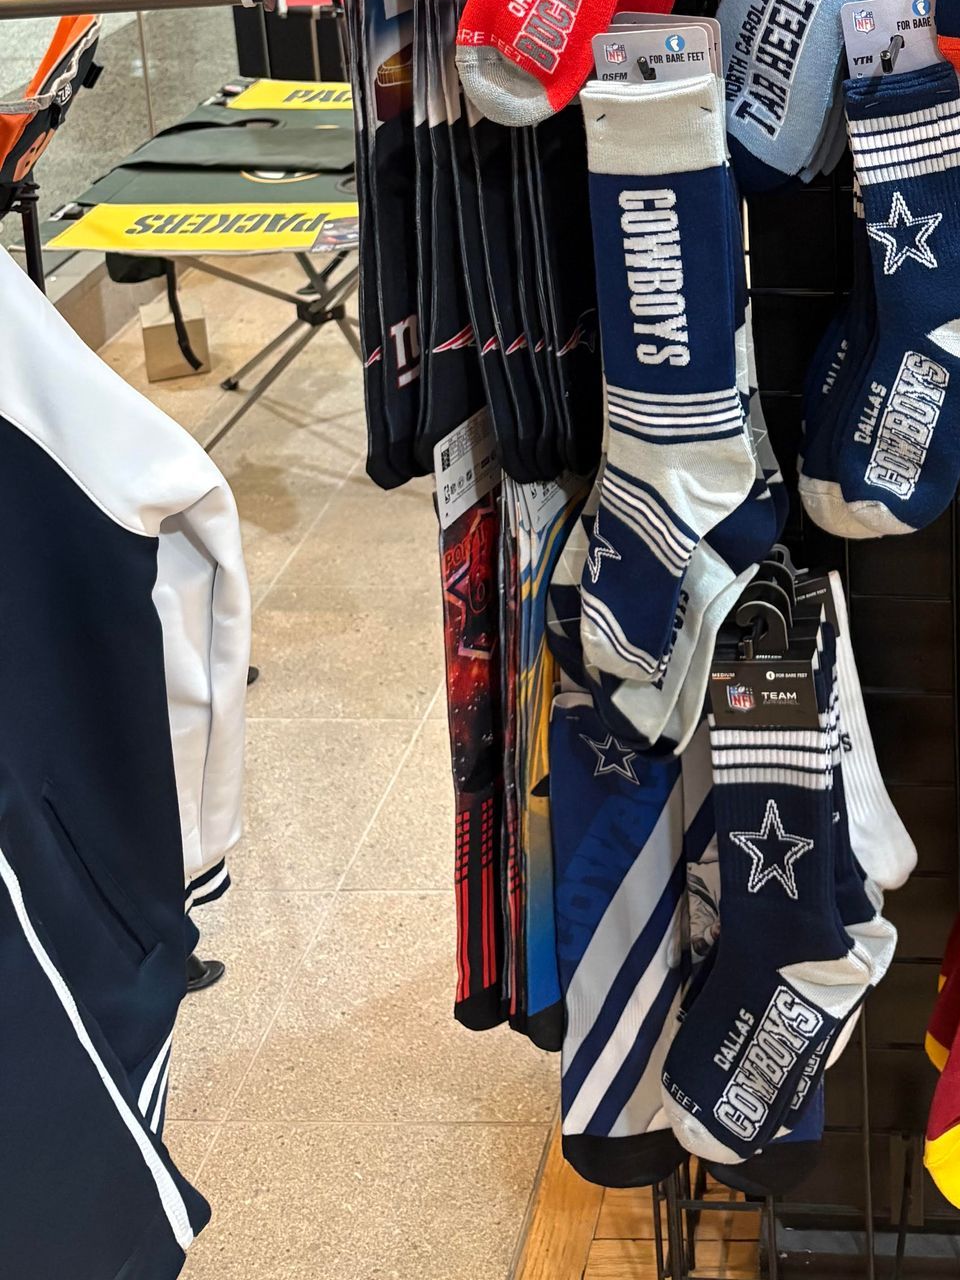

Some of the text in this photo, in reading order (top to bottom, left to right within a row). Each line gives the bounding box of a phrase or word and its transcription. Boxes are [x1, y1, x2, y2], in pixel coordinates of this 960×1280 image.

[897, 17, 932, 31] FOR BARE
[489, 34, 527, 64] FEET
[649, 51, 705, 65] FOR BARE FEET
[853, 55, 874, 66] YTH
[601, 71, 628, 81] OSFM
[725, 56, 748, 104] NORTH
[283, 89, 353, 104] PAC
[731, 69, 790, 140] TAR
[125, 212, 330, 235] PACKERS
[618, 188, 691, 368] COWBOYS
[854, 381, 888, 446] DALLAS
[864, 350, 950, 501] COWBOYS
[761, 691, 797, 700] TEAM
[713, 1007, 755, 1072] DALLAS
[713, 985, 824, 1142] COWBOYS
[670, 1083, 702, 1115] FEET
